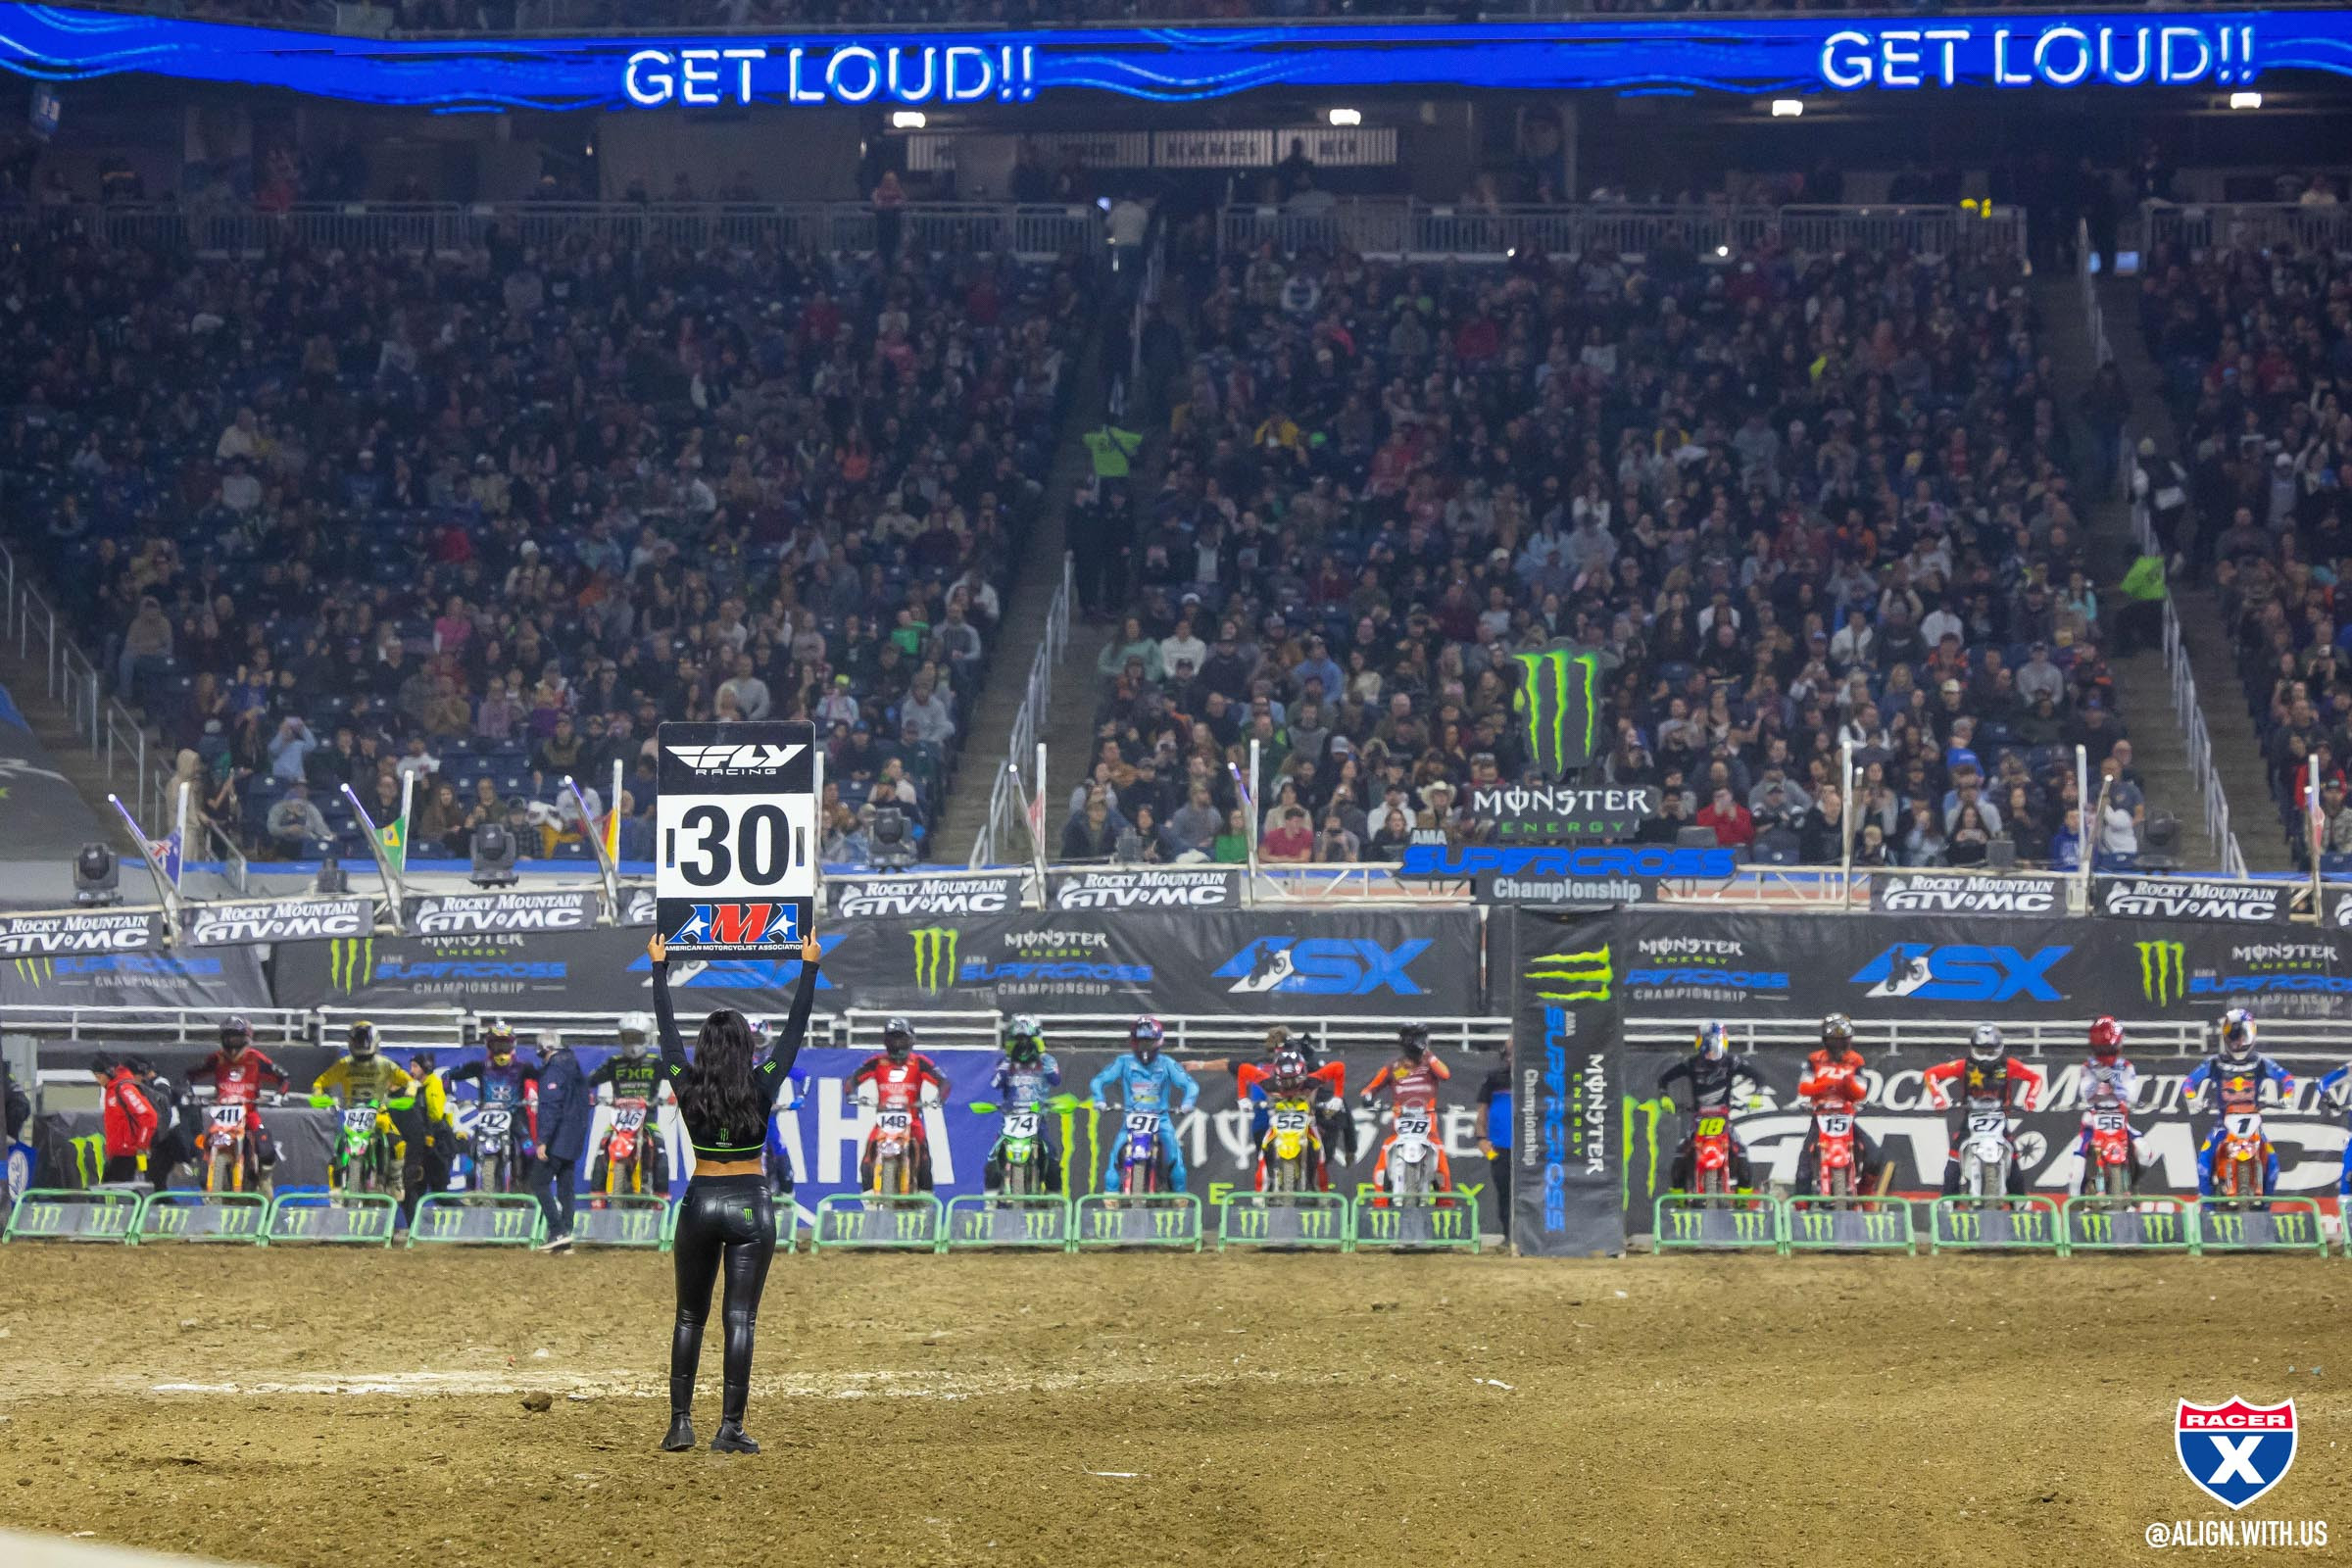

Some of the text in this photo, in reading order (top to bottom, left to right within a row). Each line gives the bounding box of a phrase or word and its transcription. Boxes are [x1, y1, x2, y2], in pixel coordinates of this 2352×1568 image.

[1821, 25, 2252, 88] GET LOUD!!
[625, 45, 1035, 105] GET LOUD!!
[664, 743, 808, 768] FLY
[695, 767, 777, 776] RACING
[1473, 785, 1652, 816] MONSTER
[1500, 821, 1625, 834] ENERGY
[680, 804, 790, 887] 30
[1411, 829, 1447, 845] AMA
[1399, 846, 1738, 877] SUPERCROSS
[866, 879, 1006, 897] ROCKY MOUNTAIN
[1085, 871, 1227, 888] ROCKY MOUNTAIN
[1911, 875, 2055, 894] ROCKY MOUNTAIN
[1493, 877, 1642, 902] Championship
[2132, 882, 2278, 903] ROCKY MOUNTAIN
[443, 893, 583, 911] ROCKY MOUNTAIN
[219, 901, 360, 922] ROCKY MOUNTAIN
[11, 914, 150, 933] ROCKY MOUNTAIN
[664, 903, 806, 944] AMA
[1004, 929, 1108, 949] MONSTER
[1638, 935, 1744, 956] MONSTER
[2231, 944, 2339, 961] MONSTER
[413, 981, 525, 995] CHAMPIONSHIP
[998, 982, 1111, 996] CHAMPIONSHIP
[1633, 988, 1747, 1003] CHAMPIONSHIP
[615, 1064, 656, 1081] FXR
[1817, 1065, 1851, 1080] FLY
[215, 1107, 240, 1123] 411
[481, 1111, 509, 1130] 92
[881, 1115, 907, 1129] 148
[1130, 1114, 1160, 1133] 91
[1277, 1114, 1304, 1130] 52
[1523, 1068, 1540, 1167] Championship
[1572, 1072, 1582, 1157] ENERGY
[1585, 1053, 1608, 1176] MONSTER
[2097, 1116, 2123, 1130] 56
[1010, 1116, 1034, 1133] 74
[1397, 1119, 1428, 1134] 28
[1697, 1117, 1726, 1137] 18
[1825, 1117, 1847, 1133] 15
[1973, 1117, 2001, 1133] 27
[2236, 1117, 2252, 1134] 1
